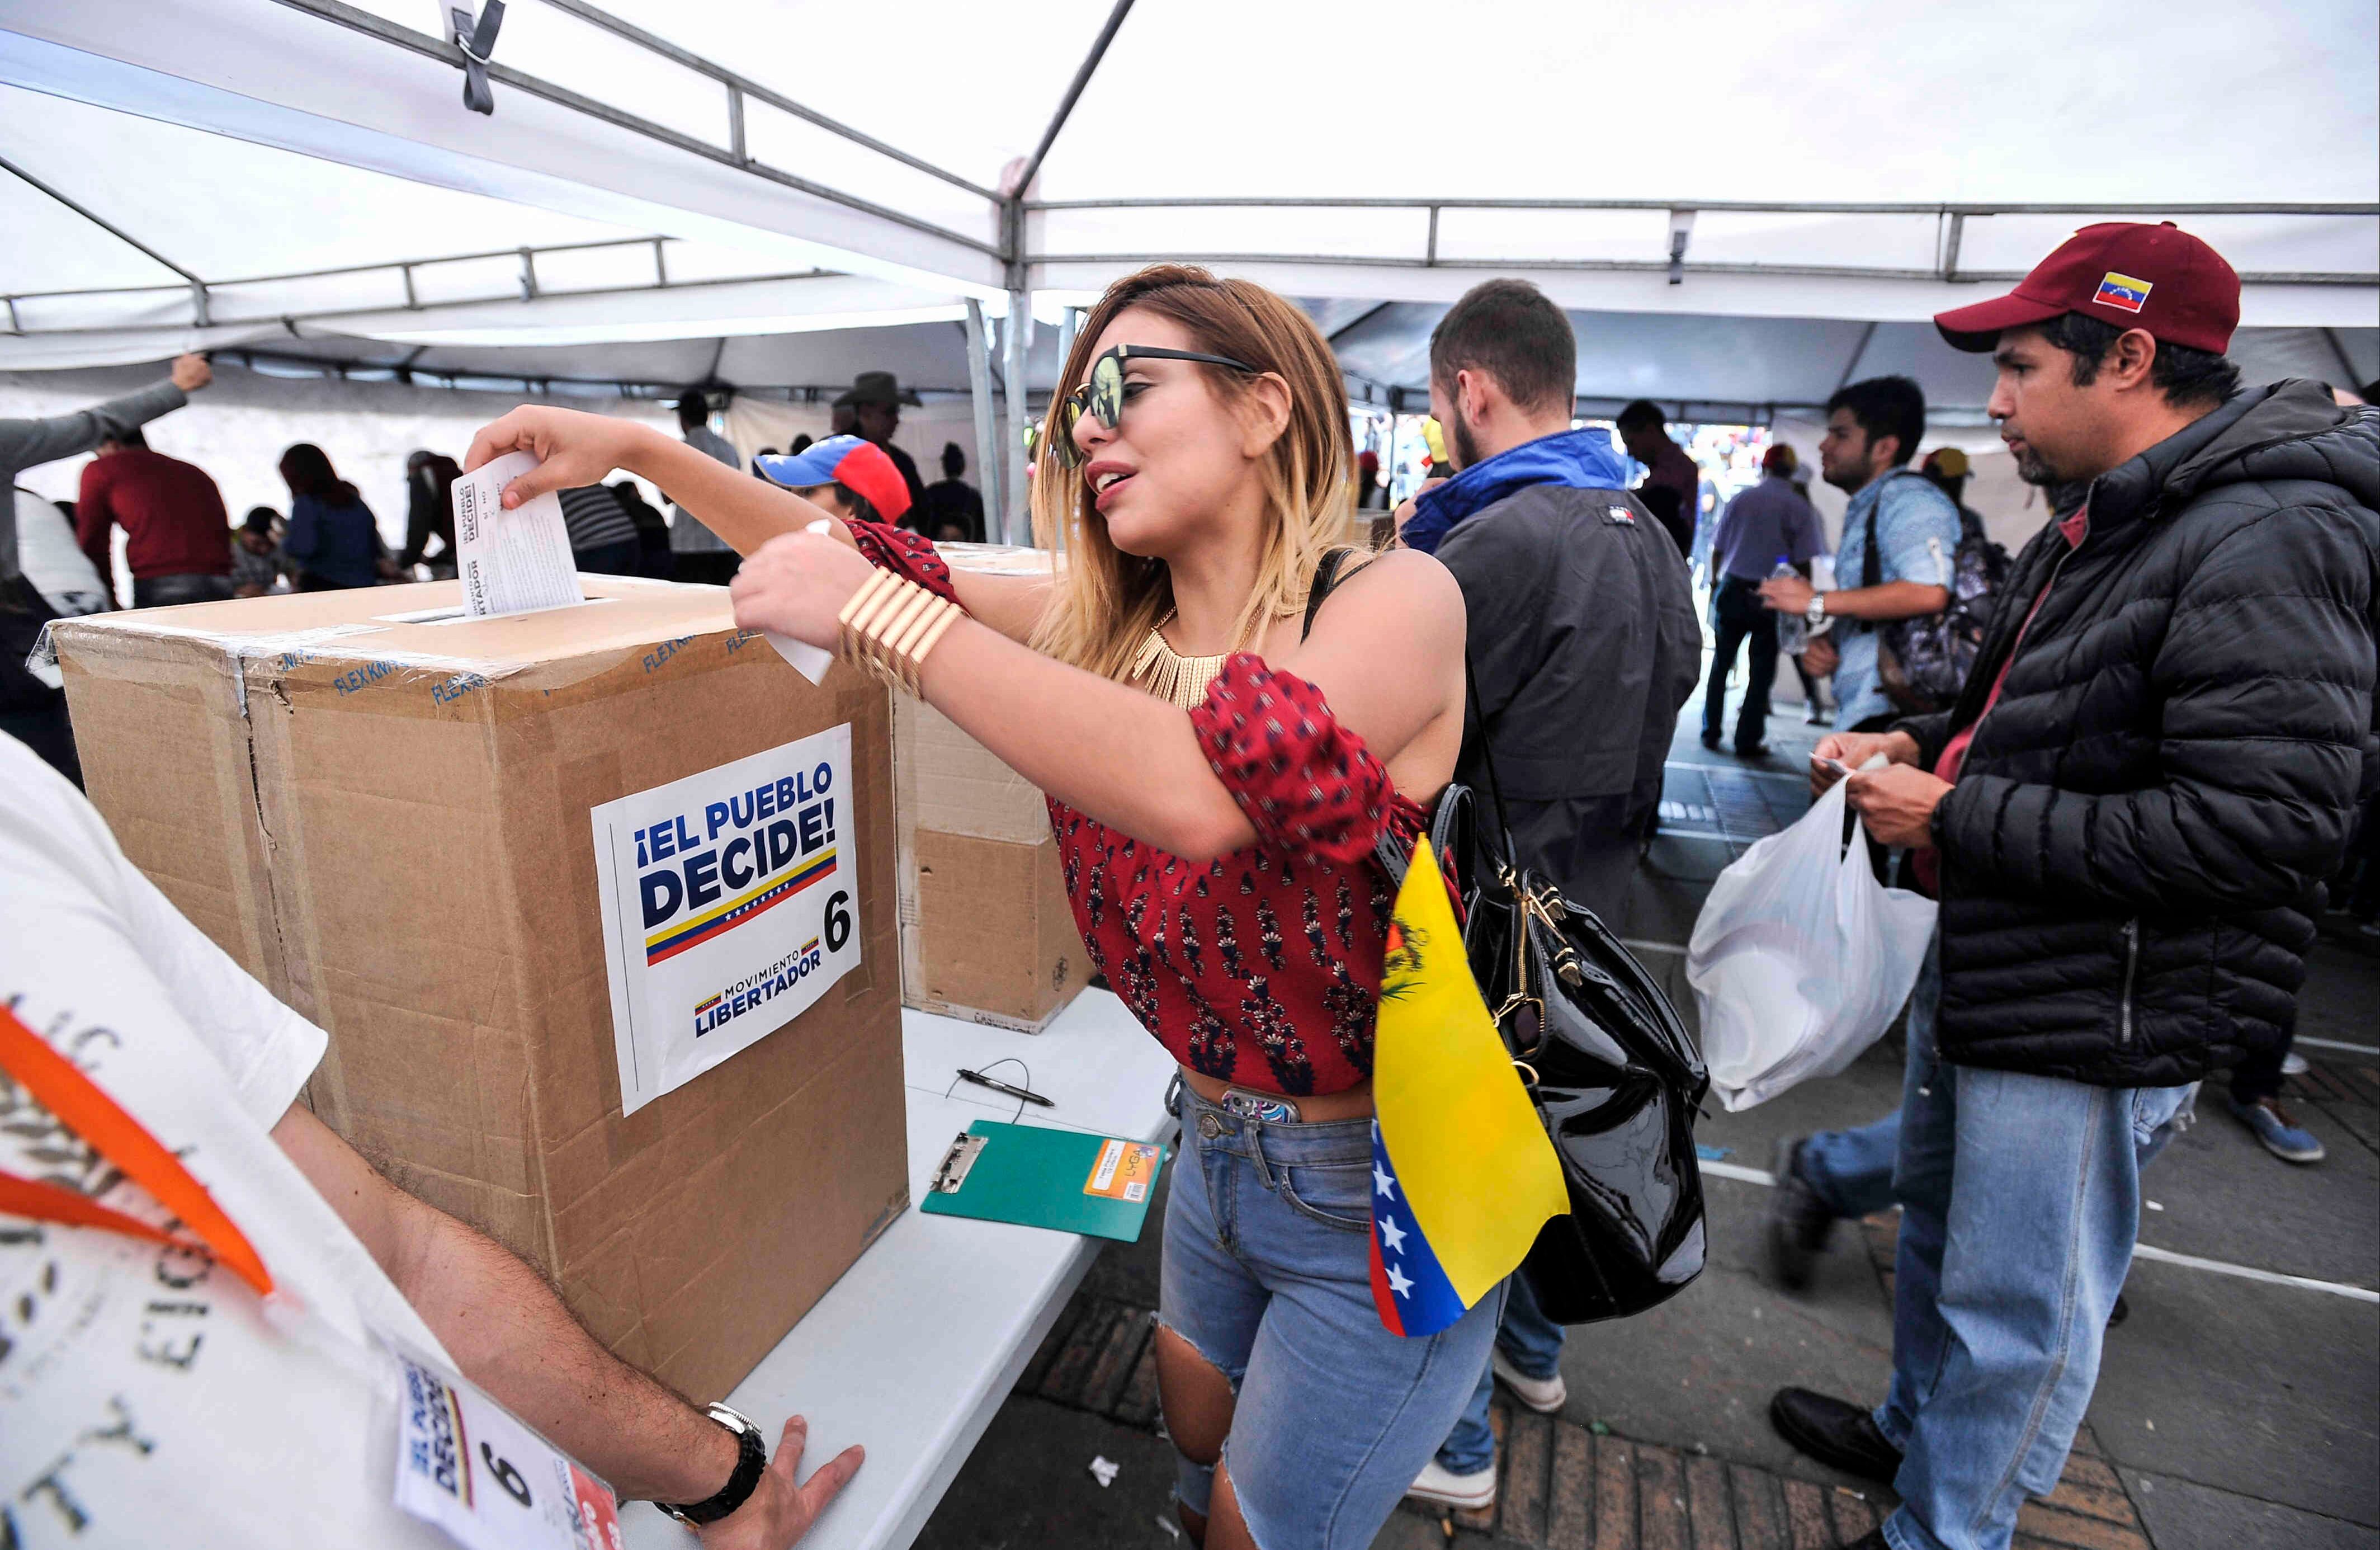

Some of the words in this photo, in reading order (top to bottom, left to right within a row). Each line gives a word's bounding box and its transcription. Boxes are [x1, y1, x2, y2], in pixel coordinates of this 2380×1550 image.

[465, 484, 475, 541] DECIDE!
[471, 560, 487, 615] RTADOR
[634, 821, 701, 868] ¡EL
[706, 762, 832, 837] PUEBLO
[639, 798, 836, 930] DECIDE!
[824, 890, 851, 954] 6
[695, 949, 821, 1039] LIBERTADOR
[725, 950, 799, 999] MOVIMIENTO
[0, 1392, 157, 1550] TY
[480, 1441, 532, 1508] 6
